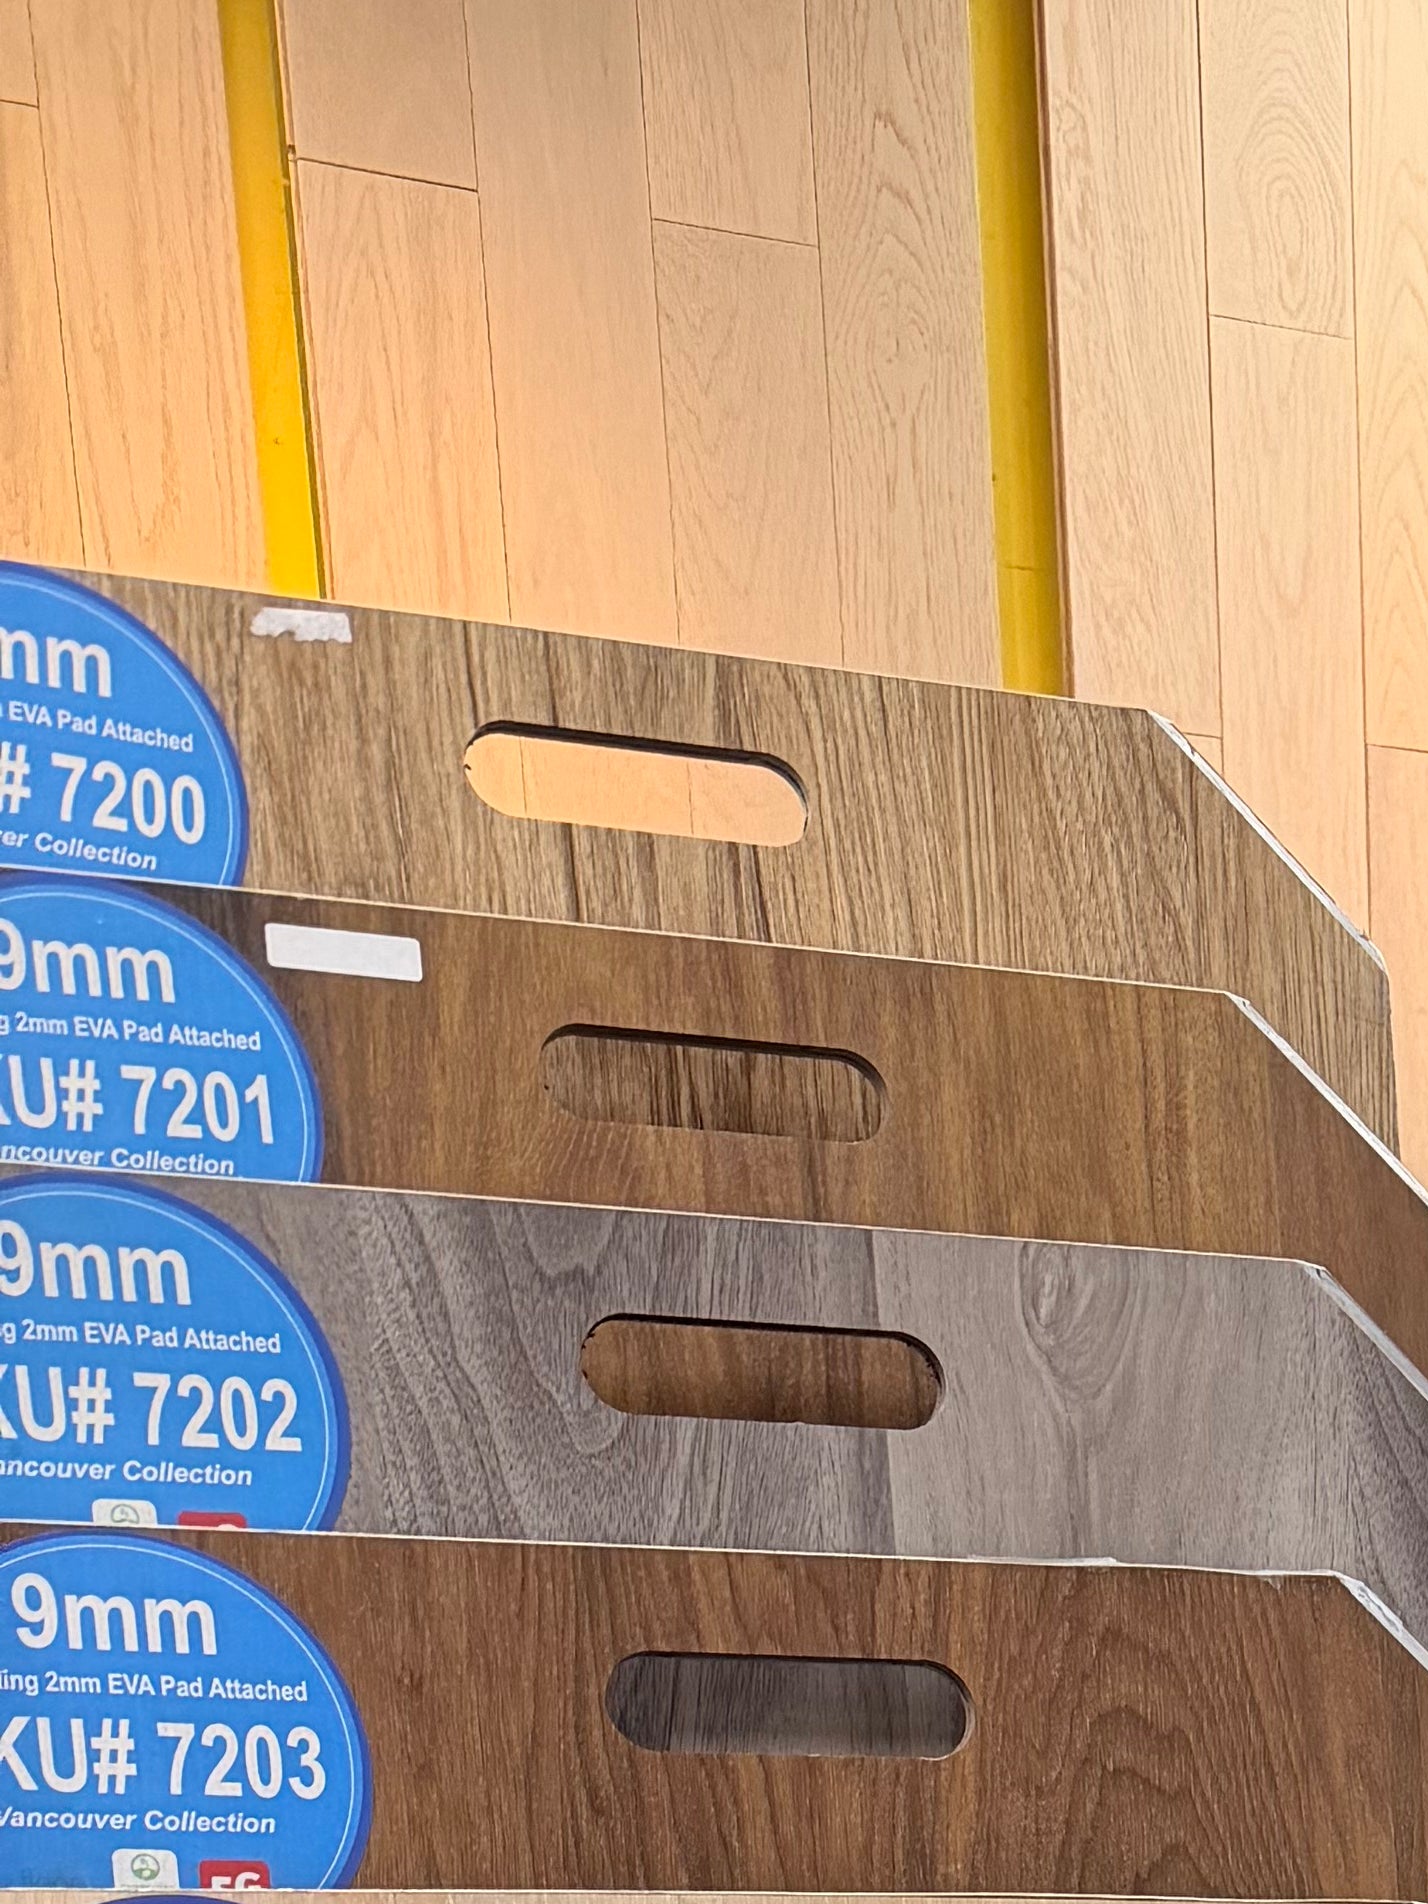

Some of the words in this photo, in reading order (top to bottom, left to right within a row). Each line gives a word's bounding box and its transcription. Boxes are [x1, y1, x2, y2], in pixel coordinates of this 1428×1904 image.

[50, 751, 207, 847] 7200
[0, 917, 176, 1003] 9mm
[120, 1064, 274, 1144] 7201
[0, 1219, 192, 1306] 9mm
[132, 1371, 302, 1452] 7202
[10, 1572, 217, 1656] 9mm
[156, 1722, 326, 1800] 7203
